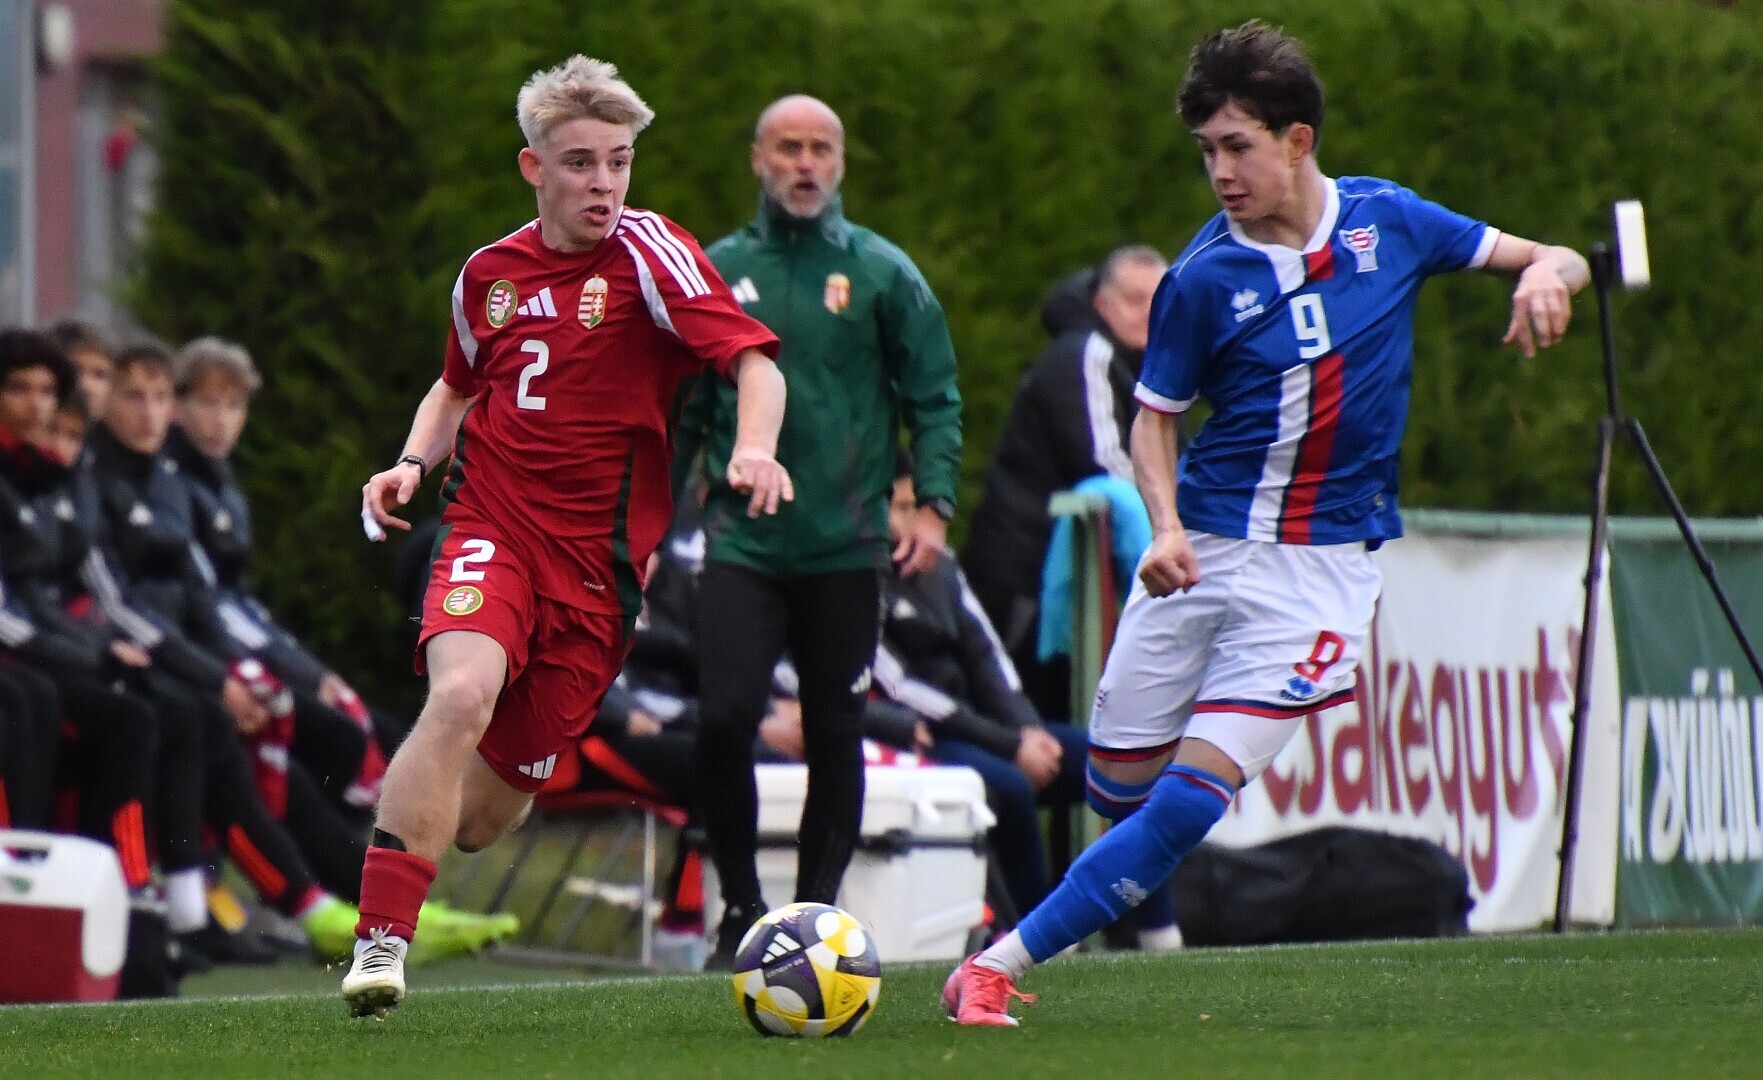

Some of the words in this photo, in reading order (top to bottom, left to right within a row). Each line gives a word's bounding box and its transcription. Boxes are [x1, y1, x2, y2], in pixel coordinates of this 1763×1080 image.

[1289, 293, 1332, 359] 9
[517, 340, 549, 410] 2
[449, 539, 495, 582] 2
[1293, 630, 1346, 683] 9
